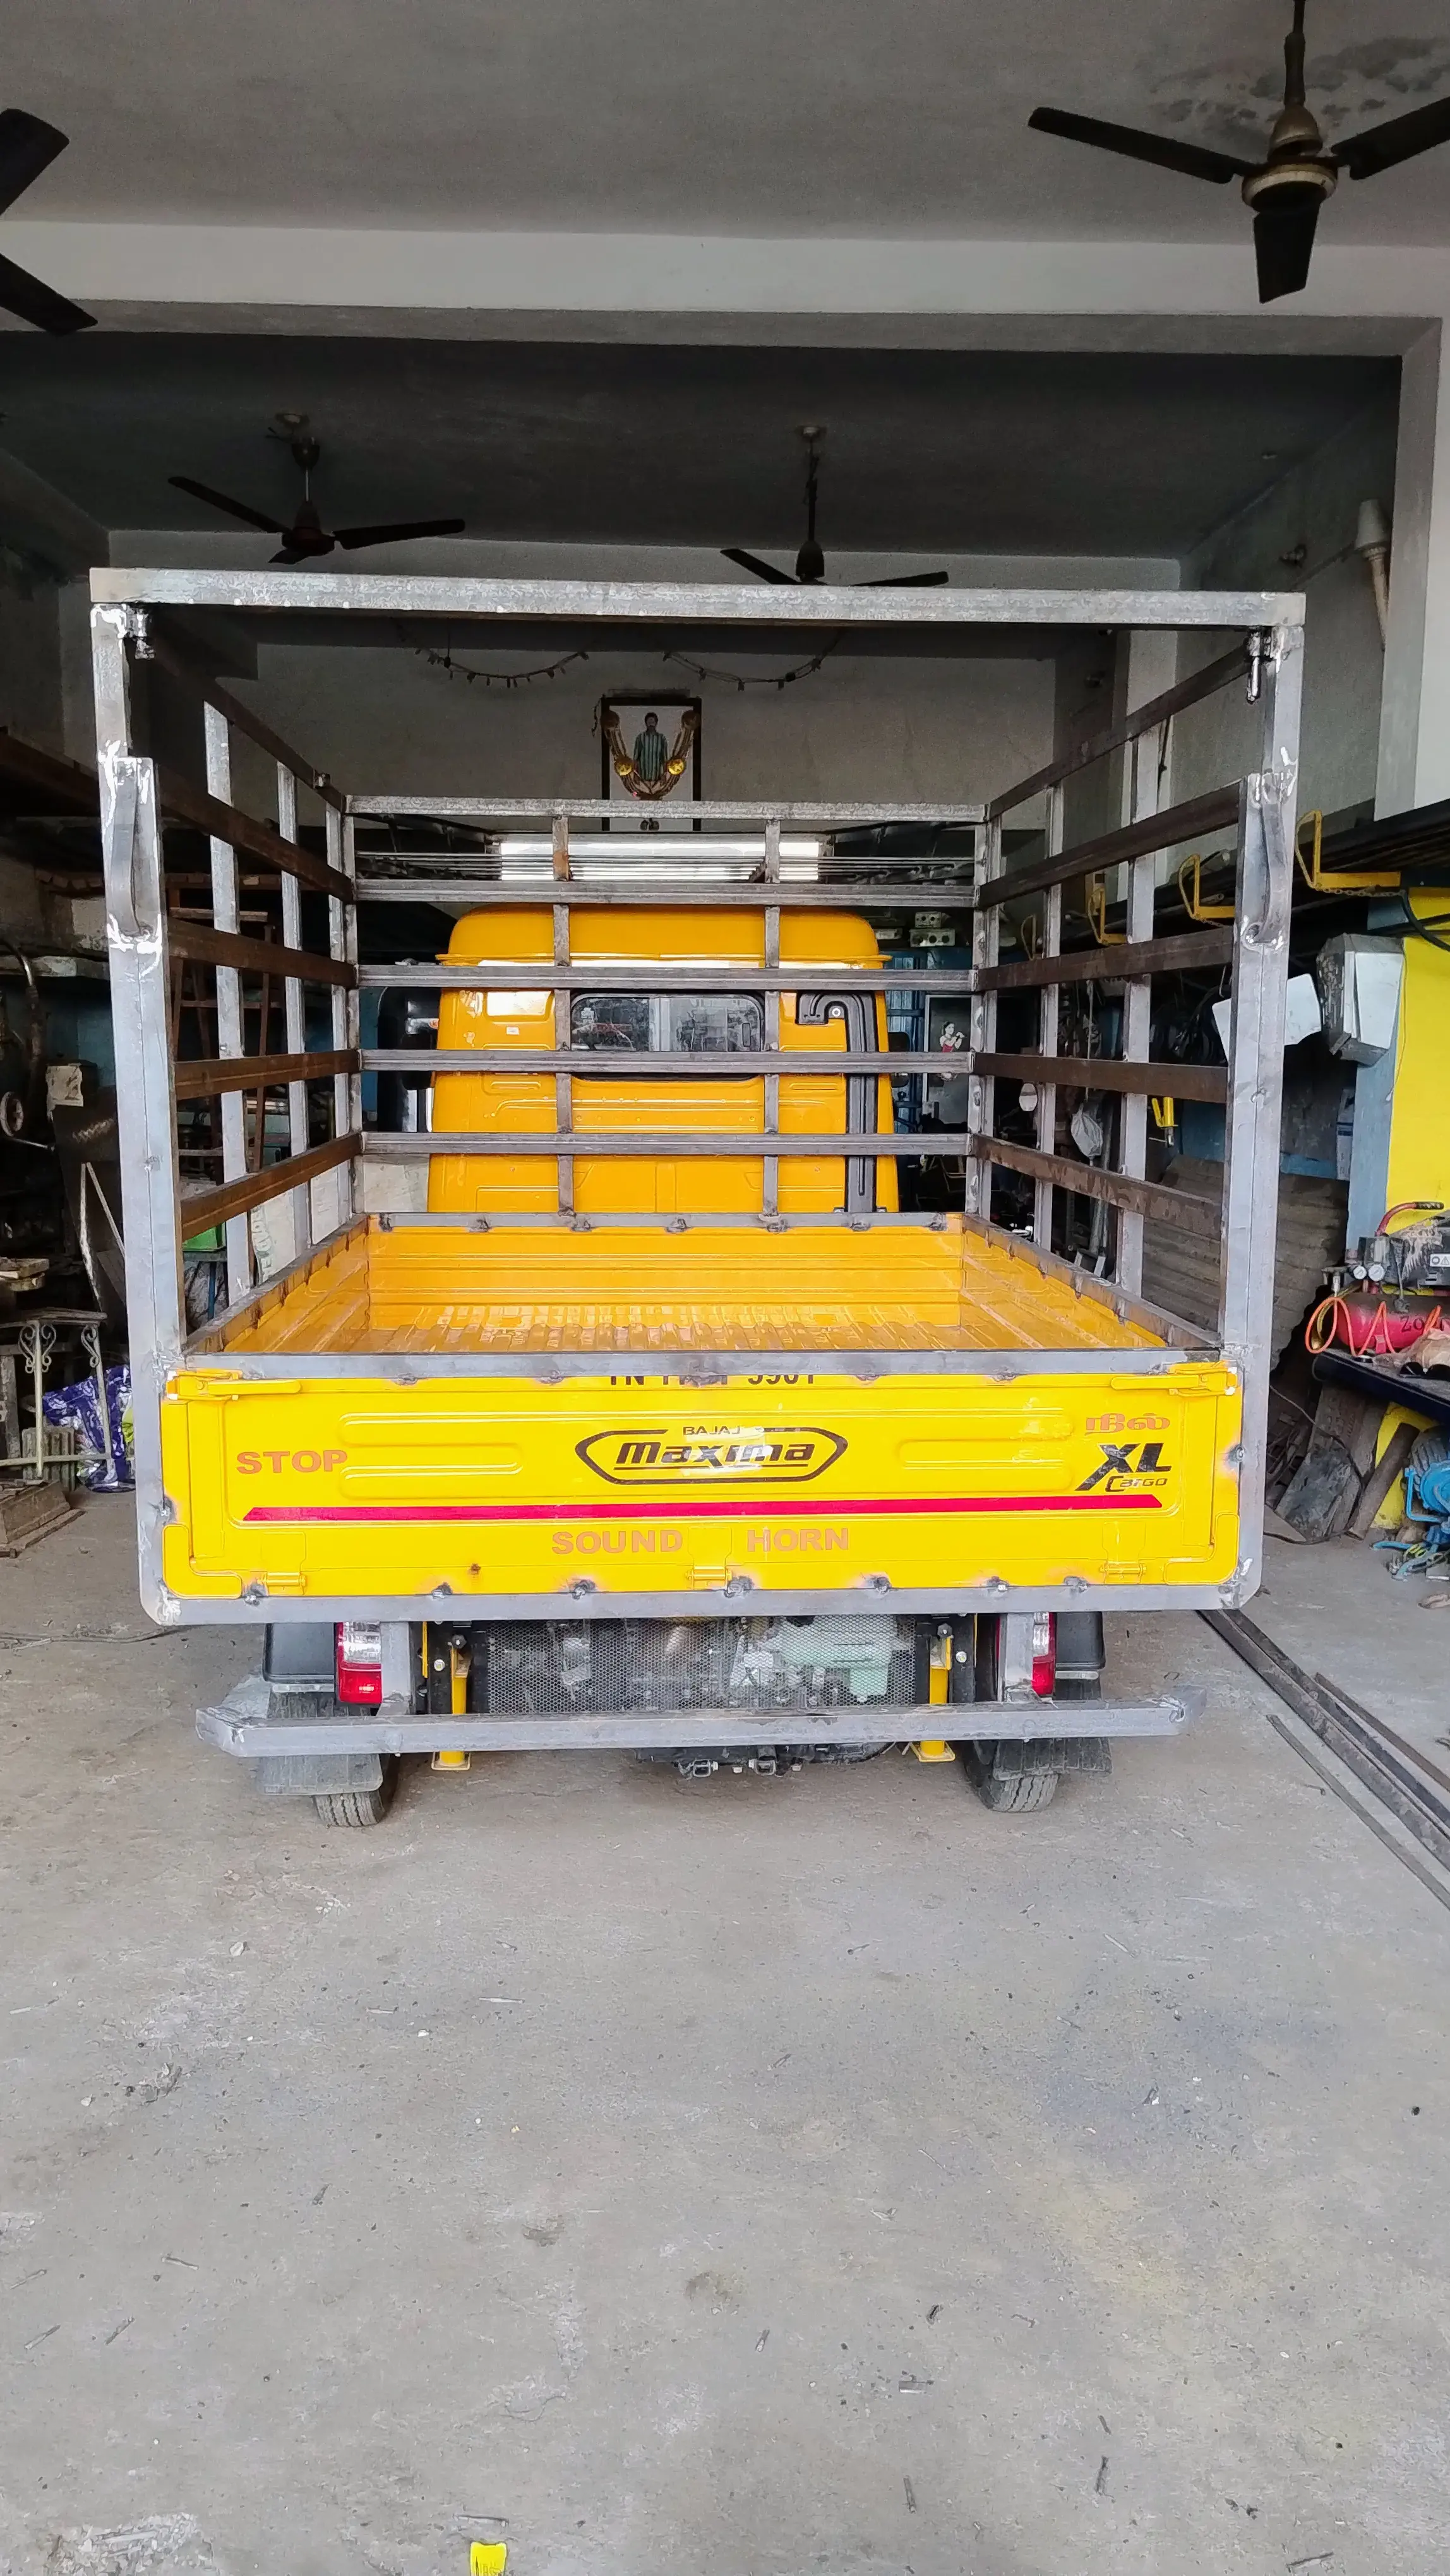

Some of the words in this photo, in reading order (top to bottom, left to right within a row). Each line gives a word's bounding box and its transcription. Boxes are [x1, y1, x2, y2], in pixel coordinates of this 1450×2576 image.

[683, 1425, 741, 1436] BAJAJ
[1084, 1412, 1170, 1436] நில்
[236, 1450, 348, 1474] STOP
[1074, 1443, 1172, 1491] XL
[551, 1530, 682, 1555] SOUND
[747, 1527, 849, 1552] HORN
